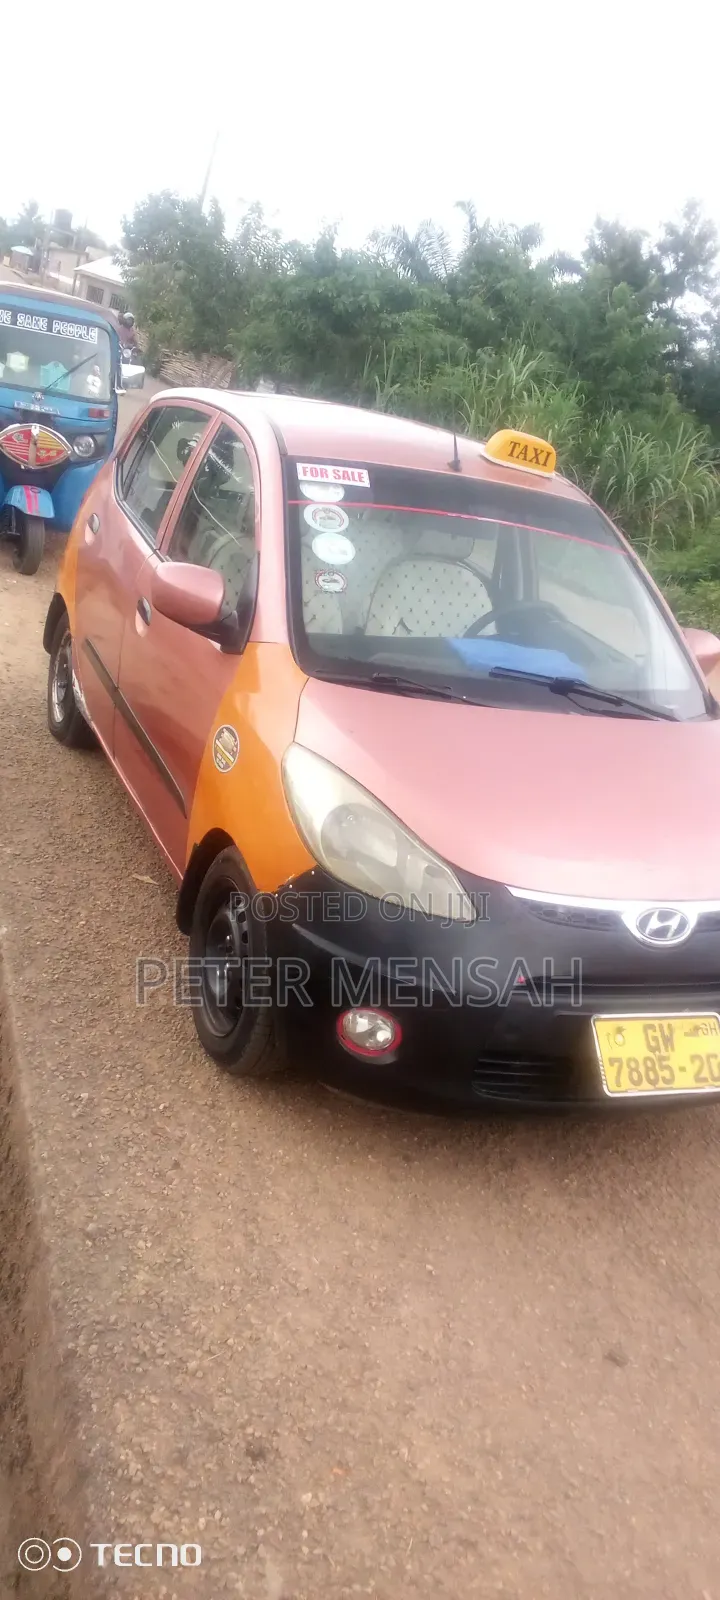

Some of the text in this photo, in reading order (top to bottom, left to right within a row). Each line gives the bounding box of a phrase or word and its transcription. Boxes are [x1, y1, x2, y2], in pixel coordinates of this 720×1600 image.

[17, 313, 48, 331] SAME
[52, 320, 97, 341] PEOPLE
[508, 441, 552, 467] TAXI
[302, 466, 366, 483] FOR SALE
[643, 1023, 675, 1054] GW
